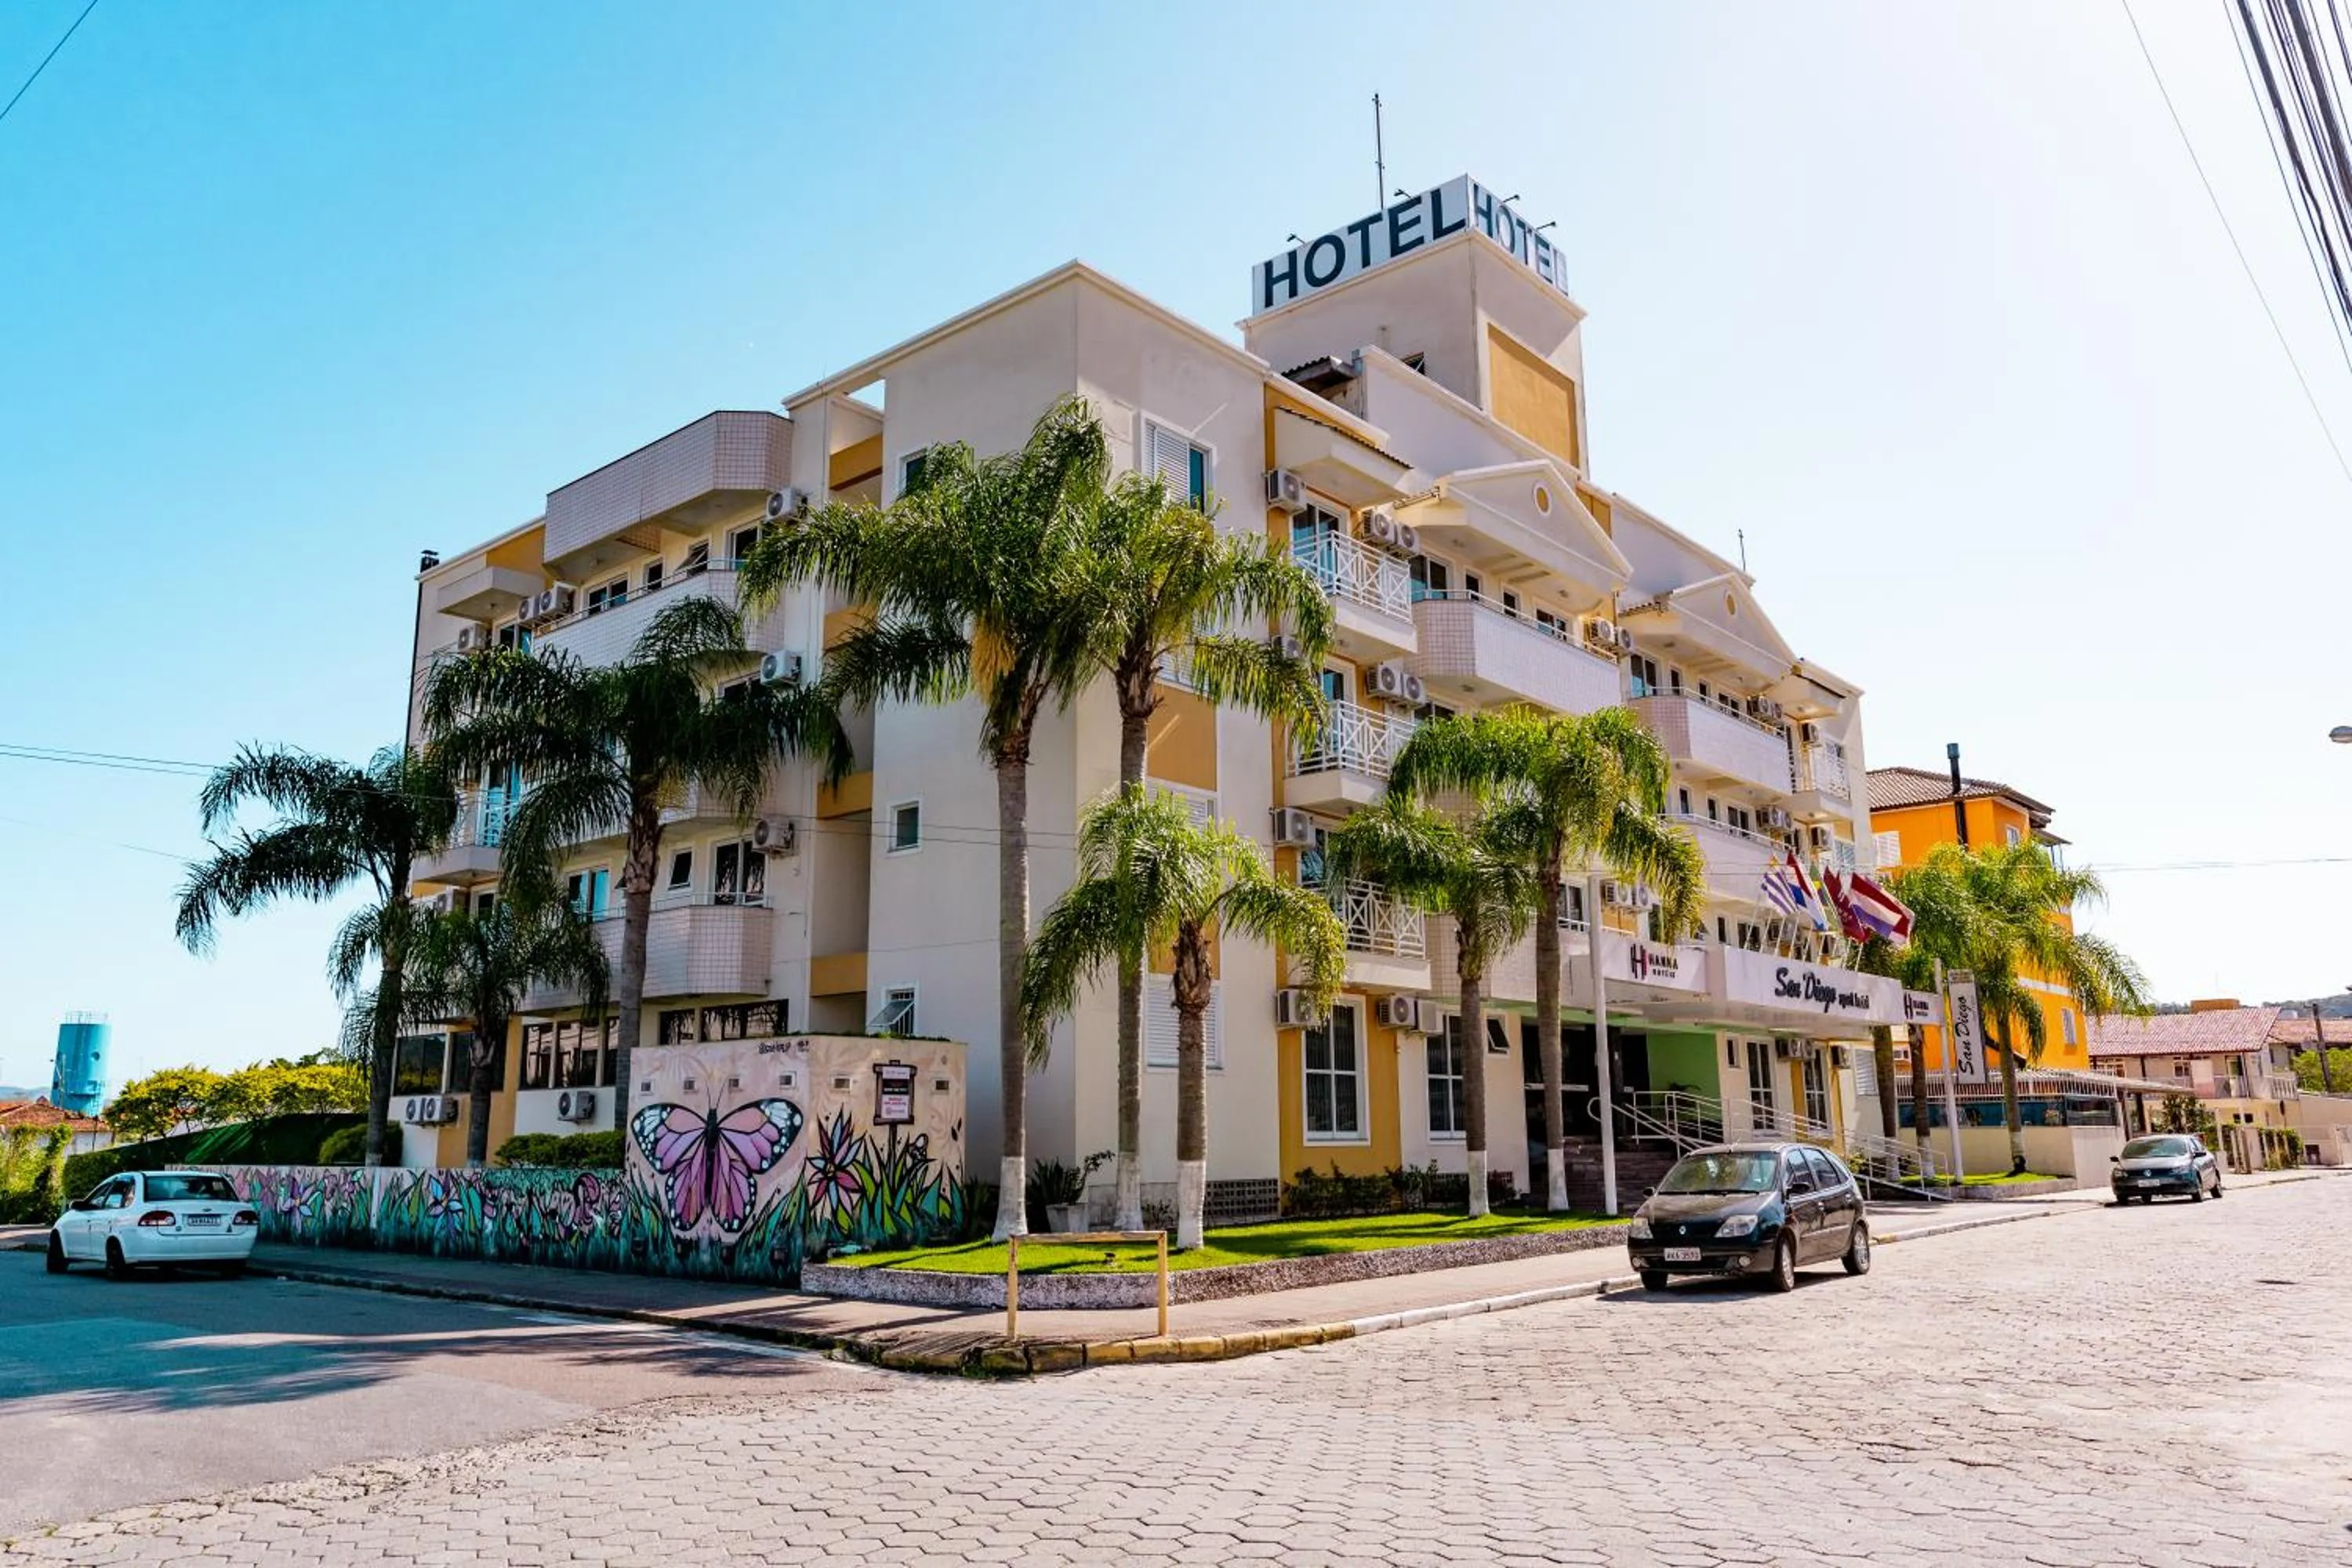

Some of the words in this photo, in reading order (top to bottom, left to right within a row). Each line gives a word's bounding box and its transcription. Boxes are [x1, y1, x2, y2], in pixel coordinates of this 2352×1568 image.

[1264, 188, 1467, 309] HOTEL
[1473, 183, 1570, 296] HOTEL
[1649, 953, 1679, 970] HANNA
[1802, 971, 1836, 1013] Diego
[1955, 996, 1973, 1037] Diego
[1958, 1041, 1974, 1075] San
